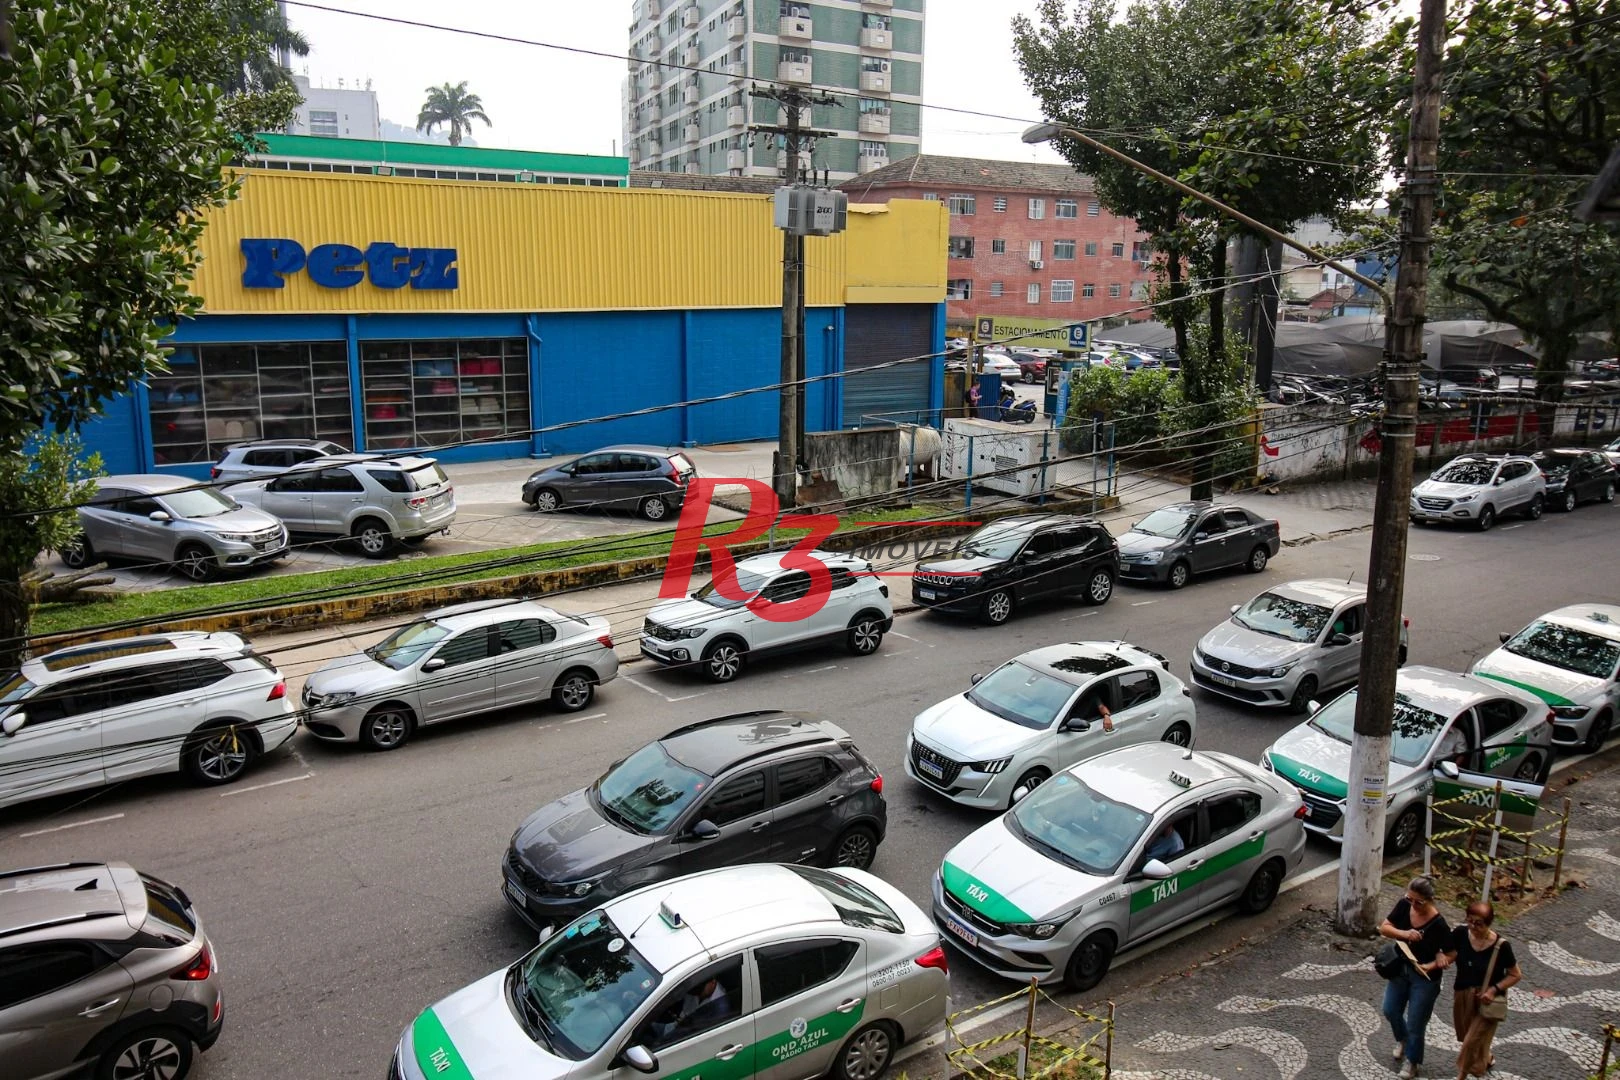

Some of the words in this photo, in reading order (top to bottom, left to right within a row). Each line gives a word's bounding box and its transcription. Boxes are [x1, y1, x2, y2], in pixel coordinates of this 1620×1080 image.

[240, 238, 458, 289] Petz
[1152, 877, 1178, 903] TÁXI
[429, 1046, 452, 1072] TÁXI
